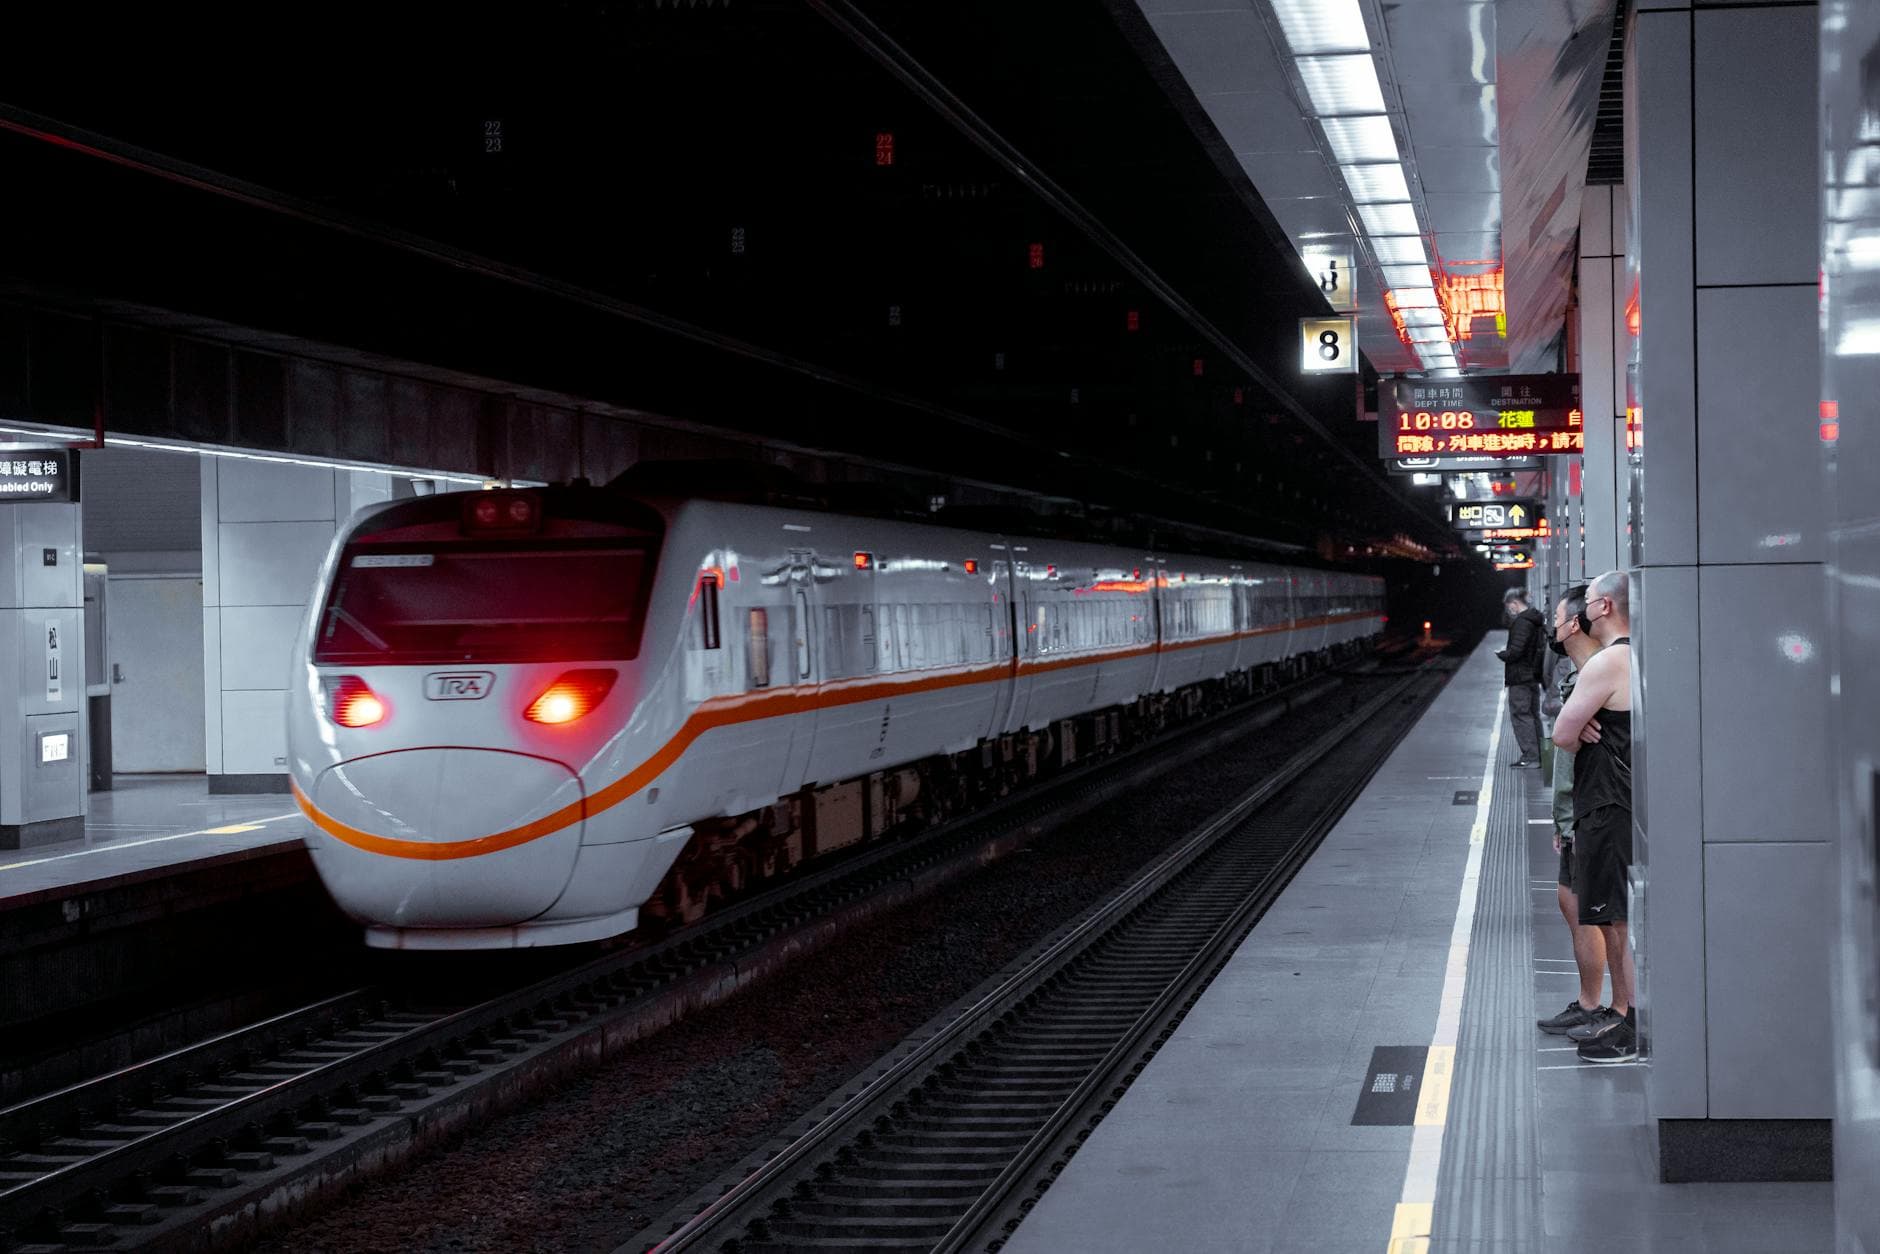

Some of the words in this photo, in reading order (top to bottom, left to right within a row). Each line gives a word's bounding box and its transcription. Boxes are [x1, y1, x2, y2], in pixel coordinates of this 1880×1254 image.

[485, 121, 501, 135] 22
[876, 134, 893, 148] 22
[876, 151, 892, 165] 24
[1319, 330, 1339, 361] 8
[1414, 388, 1463, 399] 開車時間
[1491, 398, 1542, 406] DESTINATION
[1400, 411, 1474, 430] 10:08
[1498, 410, 1535, 428] 花蓮
[30, 481, 54, 493] Only
[436, 675, 482, 694] TRA
